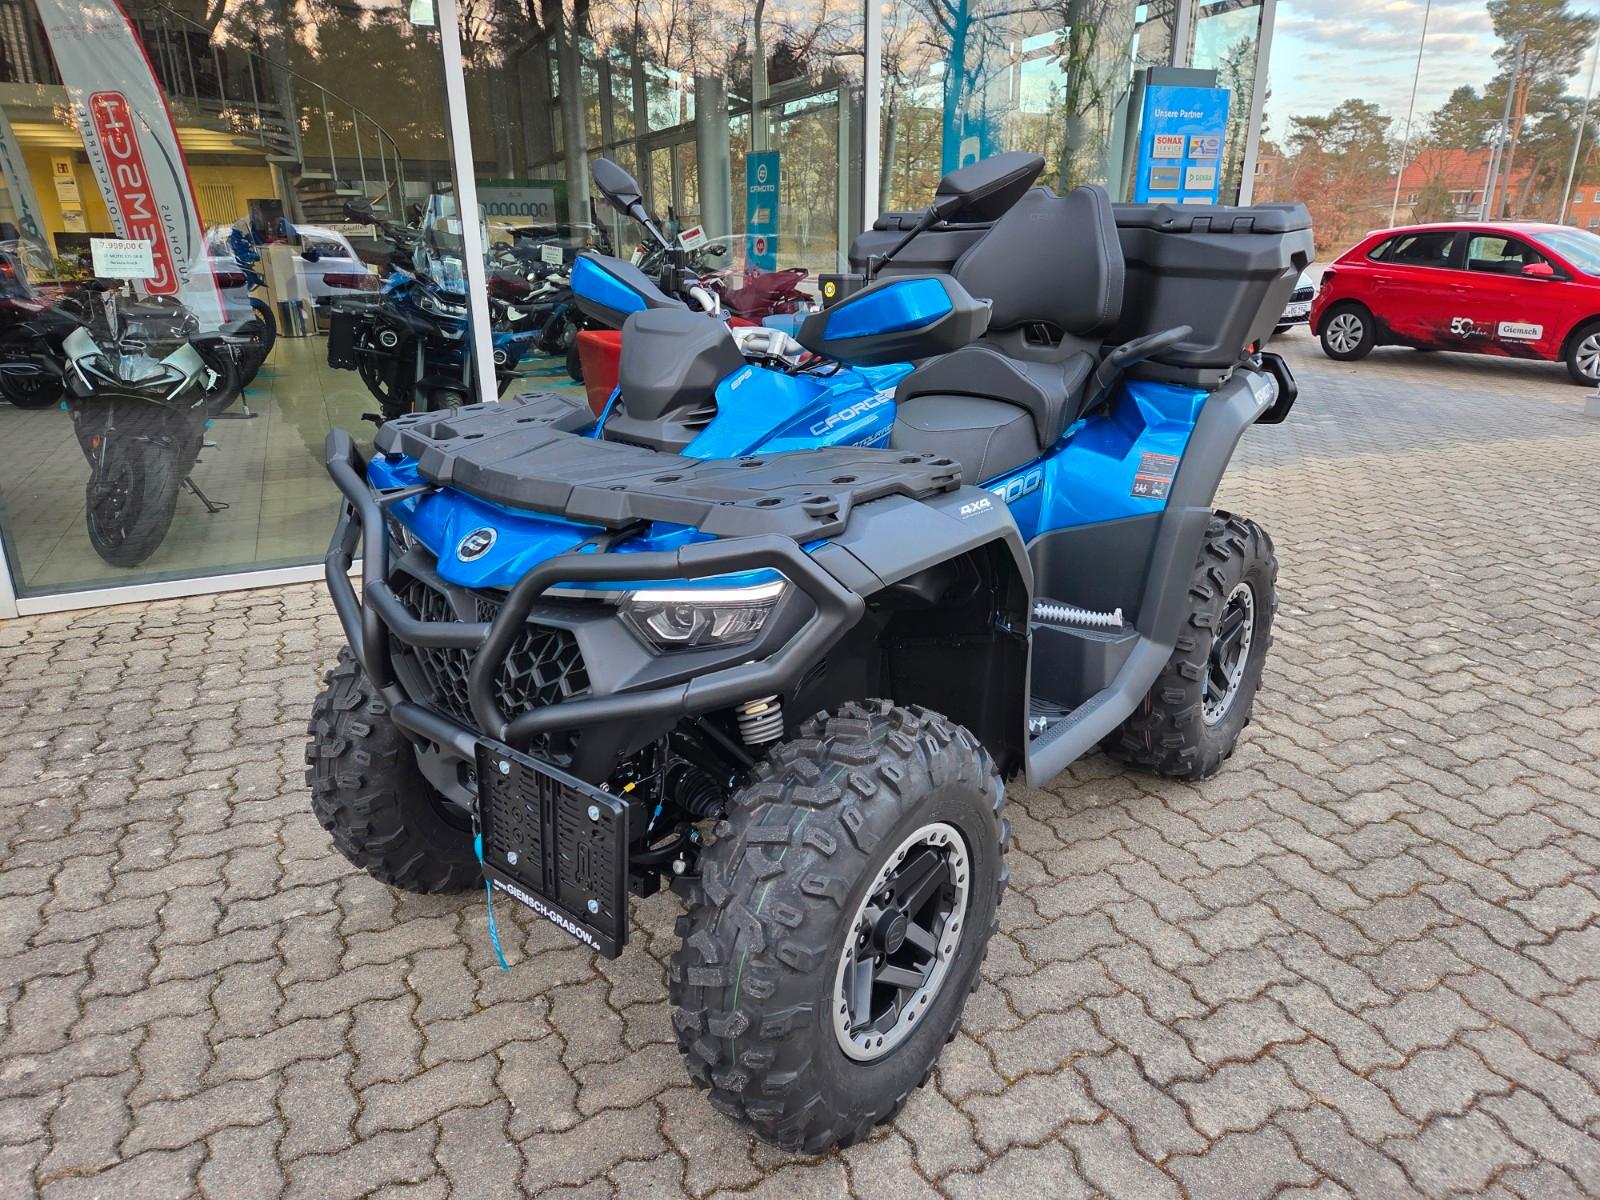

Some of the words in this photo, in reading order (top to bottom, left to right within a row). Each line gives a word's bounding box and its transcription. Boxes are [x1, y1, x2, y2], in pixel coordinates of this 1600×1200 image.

[1154, 109, 1179, 118] Unsere
[1180, 109, 1204, 119] Partner
[750, 184, 775, 193] CFMOTO
[1503, 325, 1538, 336] Giemsch
[730, 369, 753, 391] EPS
[809, 389, 892, 437] CFORCE
